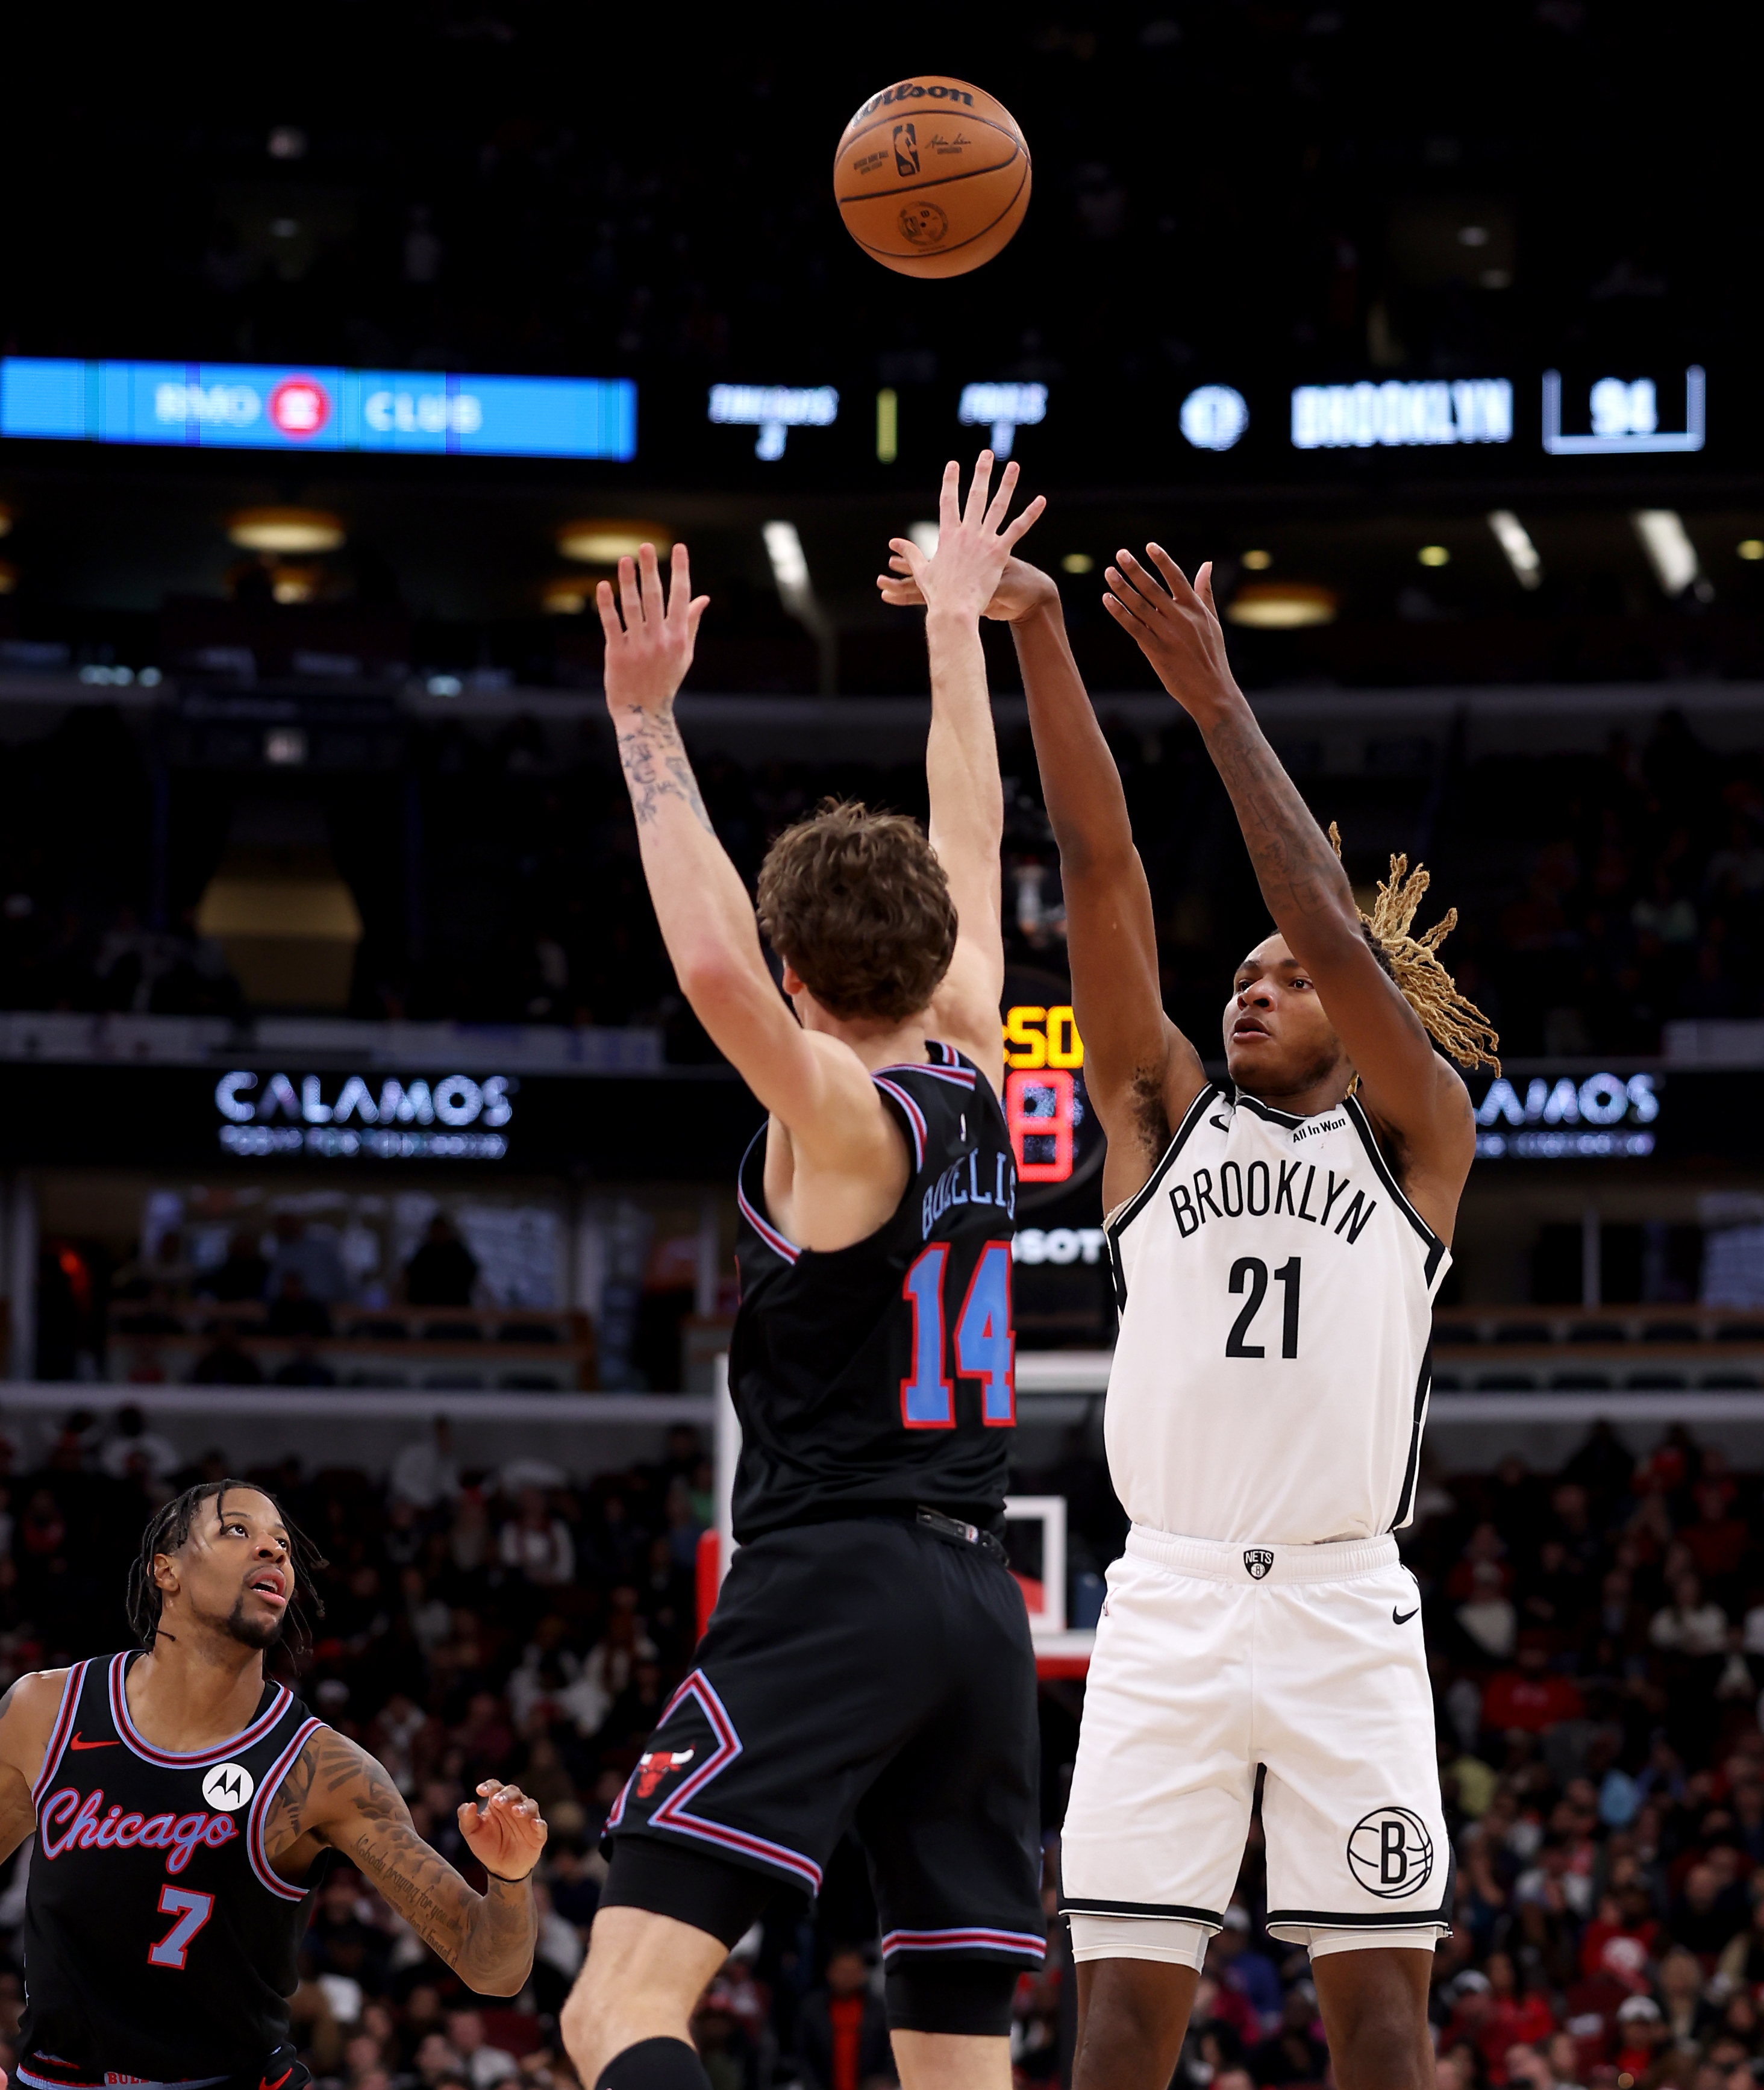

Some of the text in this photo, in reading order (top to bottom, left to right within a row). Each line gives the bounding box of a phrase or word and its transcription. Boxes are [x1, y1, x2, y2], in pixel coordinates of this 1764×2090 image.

[215, 1071, 515, 1126] CALAMOS
[1474, 1072, 1660, 1126] AMOS
[1293, 1118, 1346, 1143] All In Won
[1169, 1160, 1377, 1245] BROOKLYN
[1012, 1228, 1106, 1265] SOT
[901, 1240, 1016, 1428] 14
[1225, 1257, 1301, 1359] 21
[1245, 1551, 1272, 1564] NETS
[40, 1787, 239, 1875] Chicago
[354, 1833, 389, 1874] Nobody
[1381, 1821, 1407, 1884] B
[148, 1884, 214, 1970] 7
